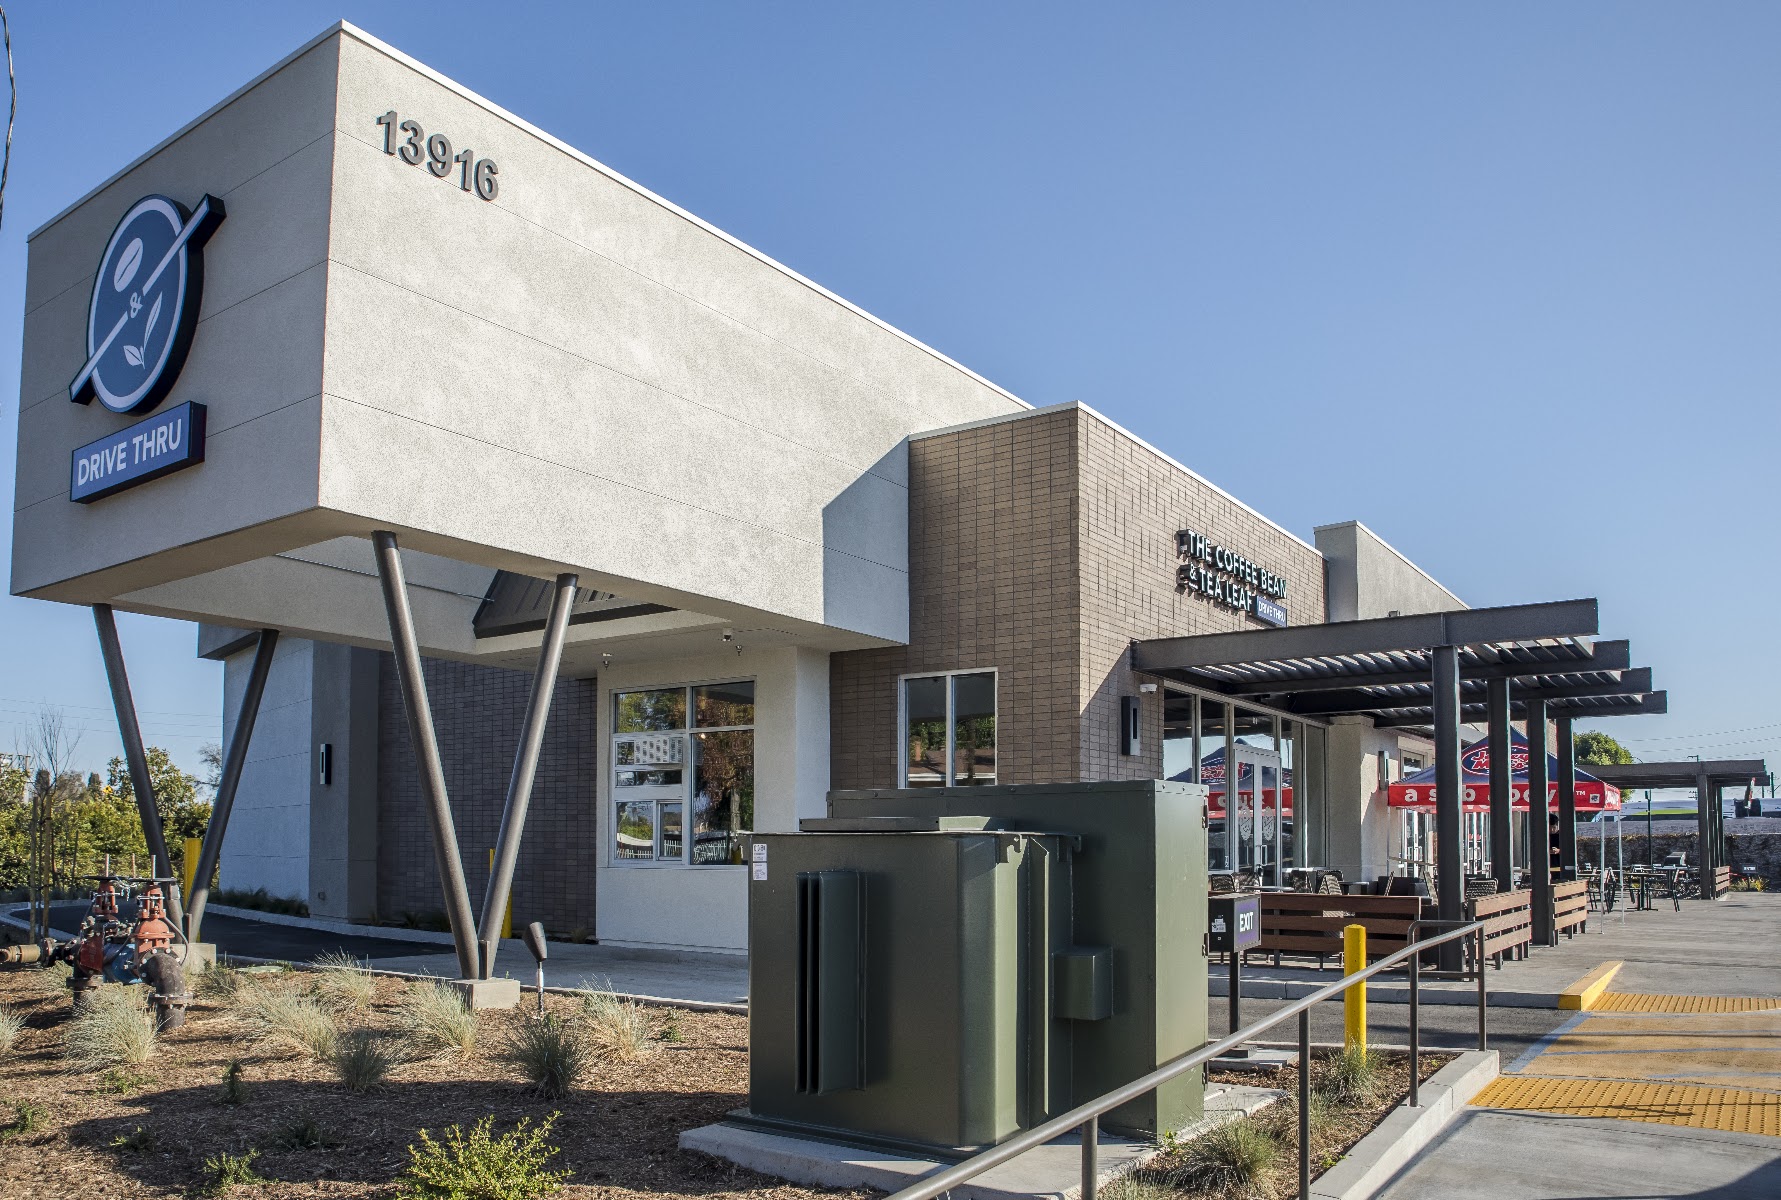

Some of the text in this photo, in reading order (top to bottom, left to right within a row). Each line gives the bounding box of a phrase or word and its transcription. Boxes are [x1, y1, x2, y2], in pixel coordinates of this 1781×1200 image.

[376, 110, 499, 201] 13916
[130, 292, 144, 319] &
[77, 418, 182, 486] DRIVE THRU
[1188, 529, 1287, 599] THE COFFEE BEAN
[1199, 567, 1223, 599] TEA
[1226, 580, 1252, 612] LEAF
[1258, 601, 1286, 623] DRIVE THRU
[1404, 788, 1418, 802] a
[1428, 785, 1476, 802] sb
[1239, 911, 1254, 932] EXIT
